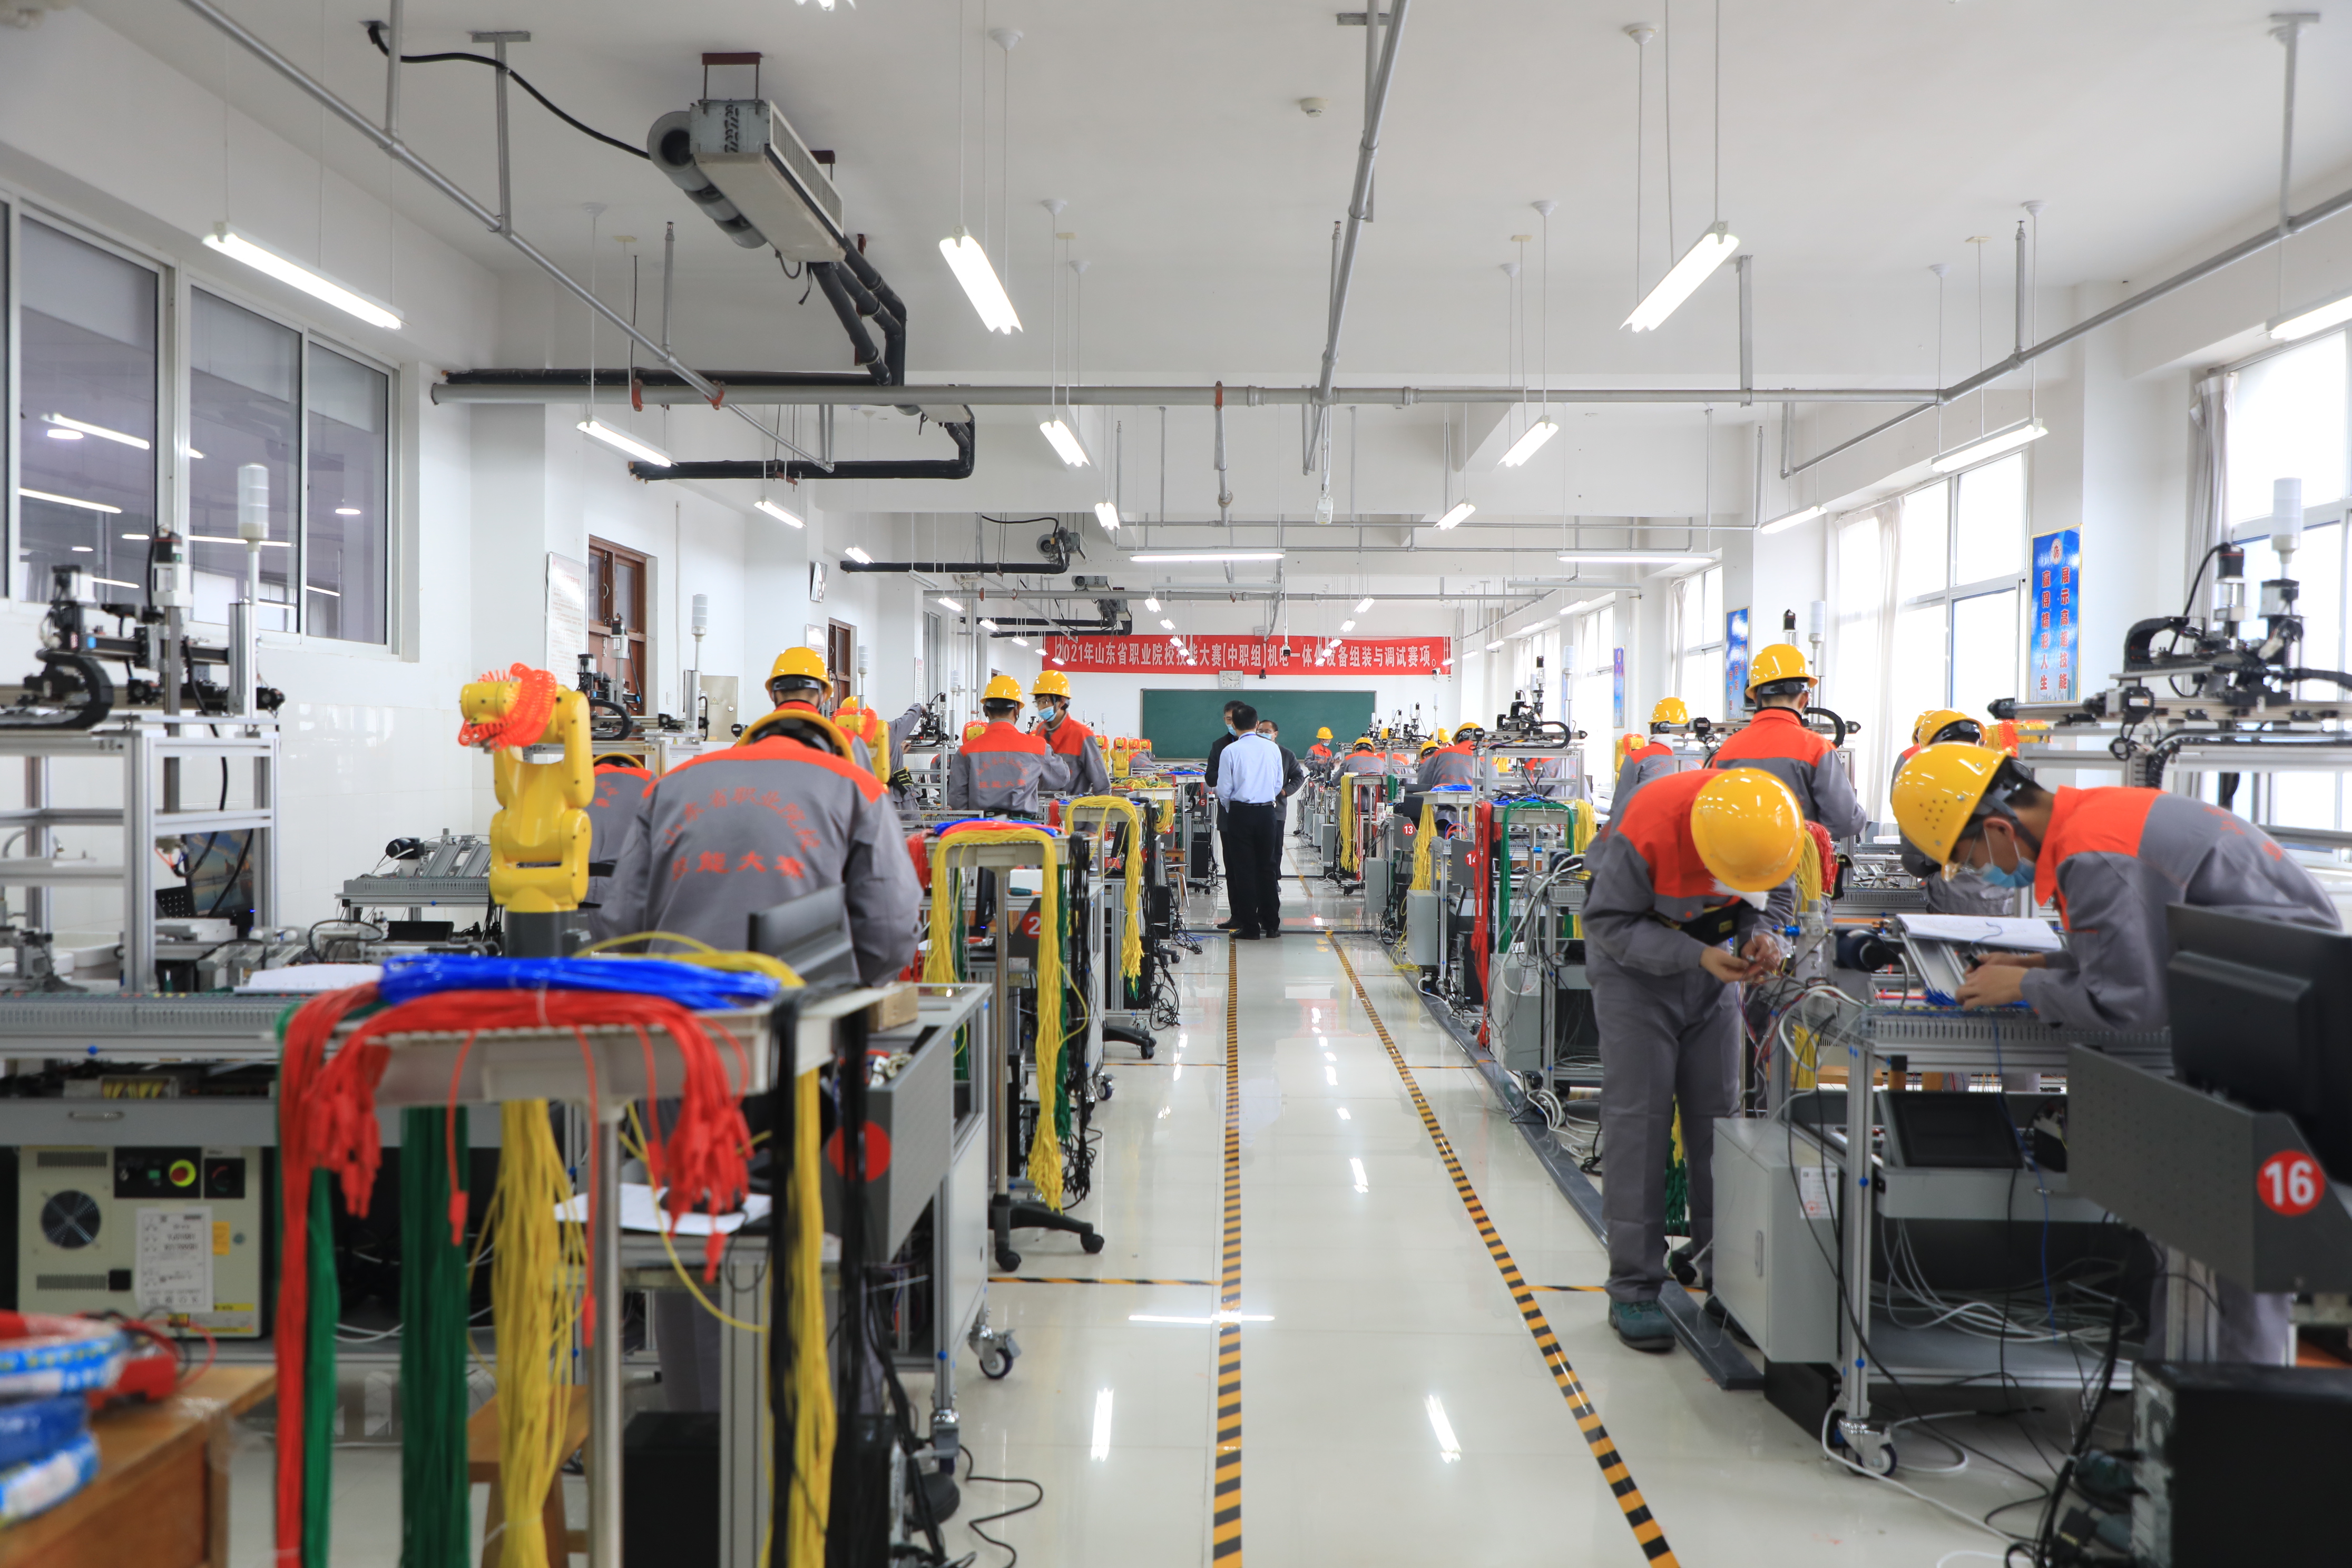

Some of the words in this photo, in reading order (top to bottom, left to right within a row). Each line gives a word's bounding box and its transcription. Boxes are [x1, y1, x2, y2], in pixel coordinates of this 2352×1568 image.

[2040, 571, 2050, 690] 赢得精彩人生
[2059, 567, 2069, 689] 展示高超技能
[1404, 825, 1413, 834] 13
[1028, 916, 1041, 935] 2
[2265, 1160, 2315, 1206] 16
